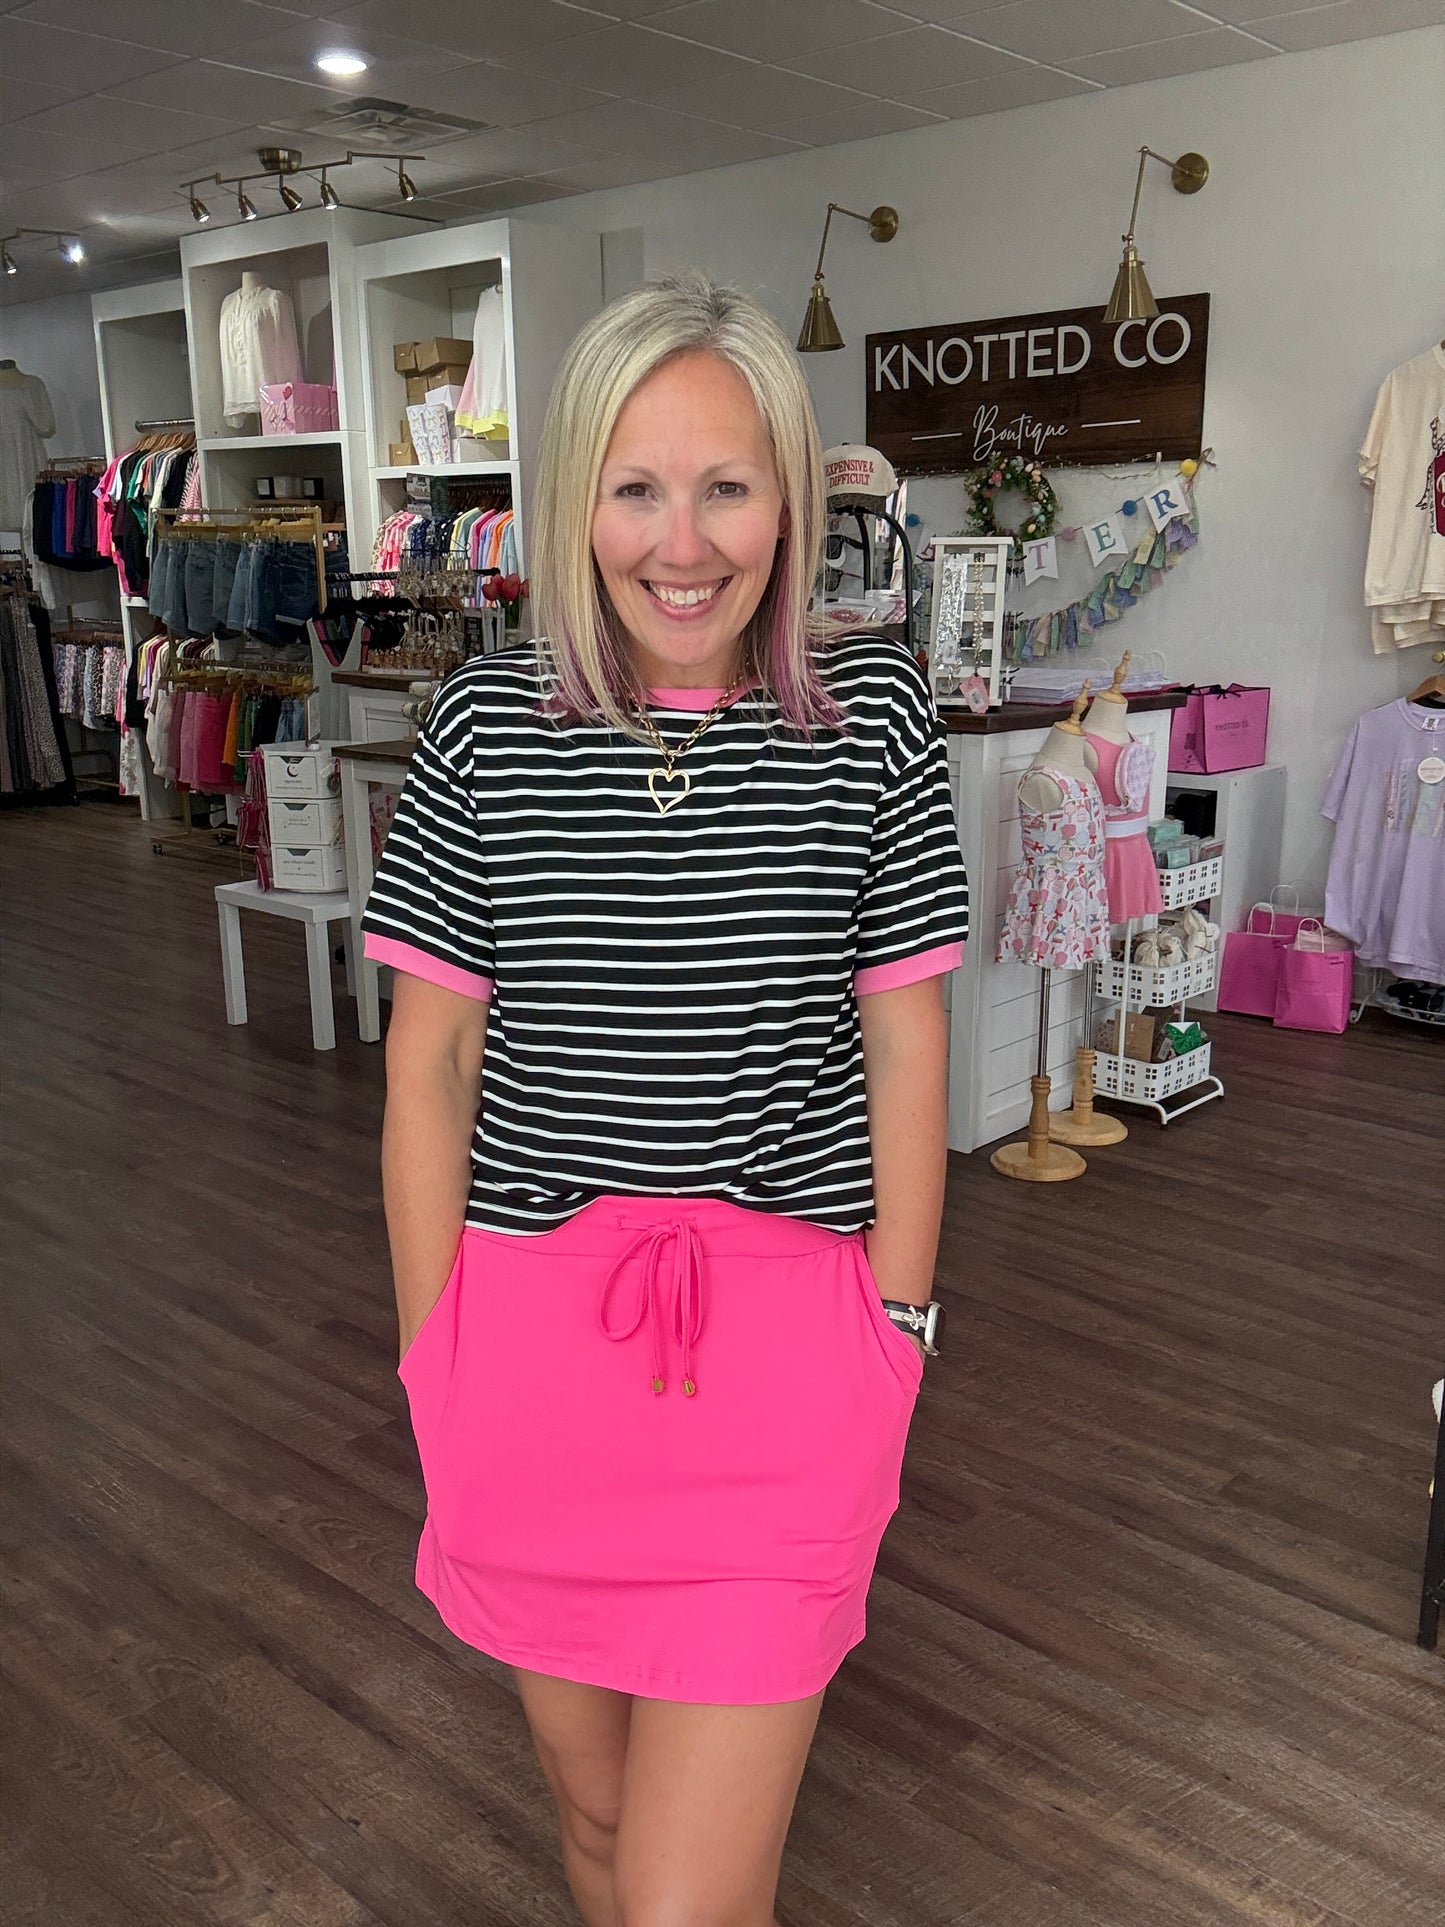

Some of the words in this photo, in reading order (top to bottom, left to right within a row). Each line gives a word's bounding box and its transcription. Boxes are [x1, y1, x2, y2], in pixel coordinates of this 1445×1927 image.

[875, 325, 1092, 392] KNOTTED
[1113, 313, 1192, 368] CO
[972, 404, 1069, 462] Boutique
[824, 459, 868, 477] EXPENSIVE
[869, 461, 875, 473] &
[829, 472, 871, 489] DIFFICULT
